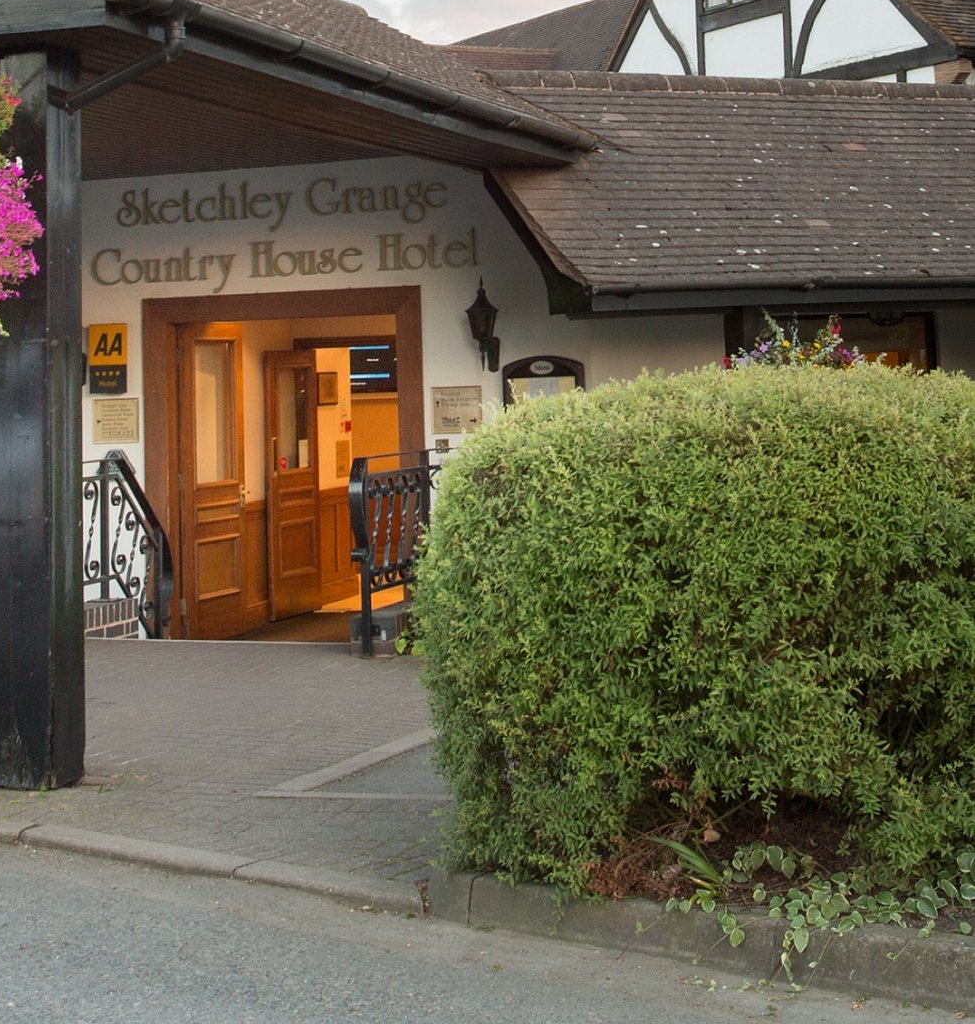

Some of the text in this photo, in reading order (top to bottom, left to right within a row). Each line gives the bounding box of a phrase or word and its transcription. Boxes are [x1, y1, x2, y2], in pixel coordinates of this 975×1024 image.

[116, 177, 447, 232] Sketchley Grange
[91, 228, 478, 294] Country House Hotel
[94, 332, 123, 356] AA
[98, 379, 118, 388] Hotel
